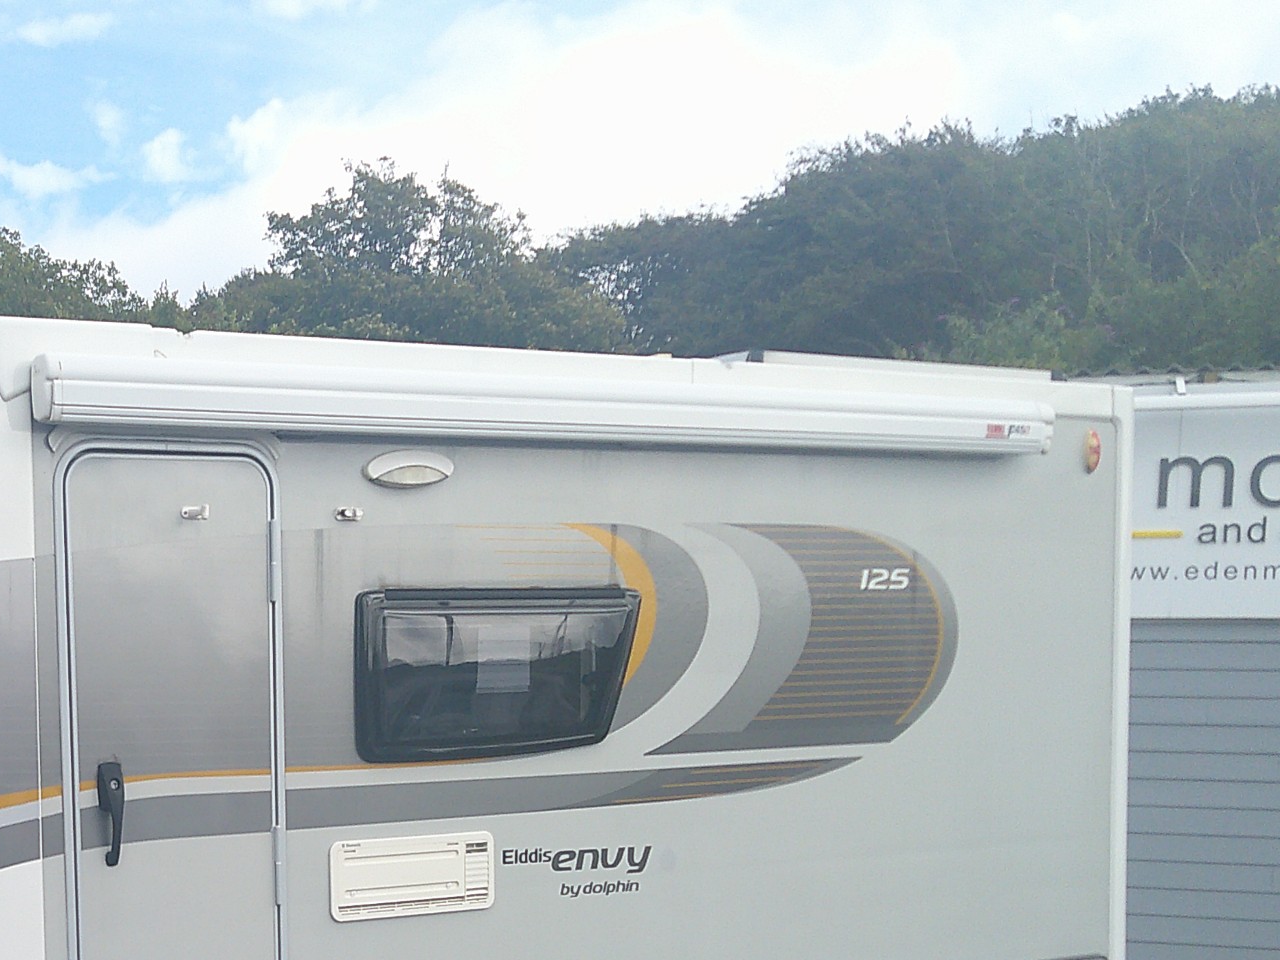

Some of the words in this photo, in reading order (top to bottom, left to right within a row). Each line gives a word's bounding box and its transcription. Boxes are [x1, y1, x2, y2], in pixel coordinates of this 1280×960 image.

[1197, 516, 1267, 544] and
[860, 567, 910, 590] 125
[502, 848, 552, 865] Elddis
[551, 846, 652, 874] envy
[560, 883, 581, 898] by
[582, 880, 640, 896] dolphin
